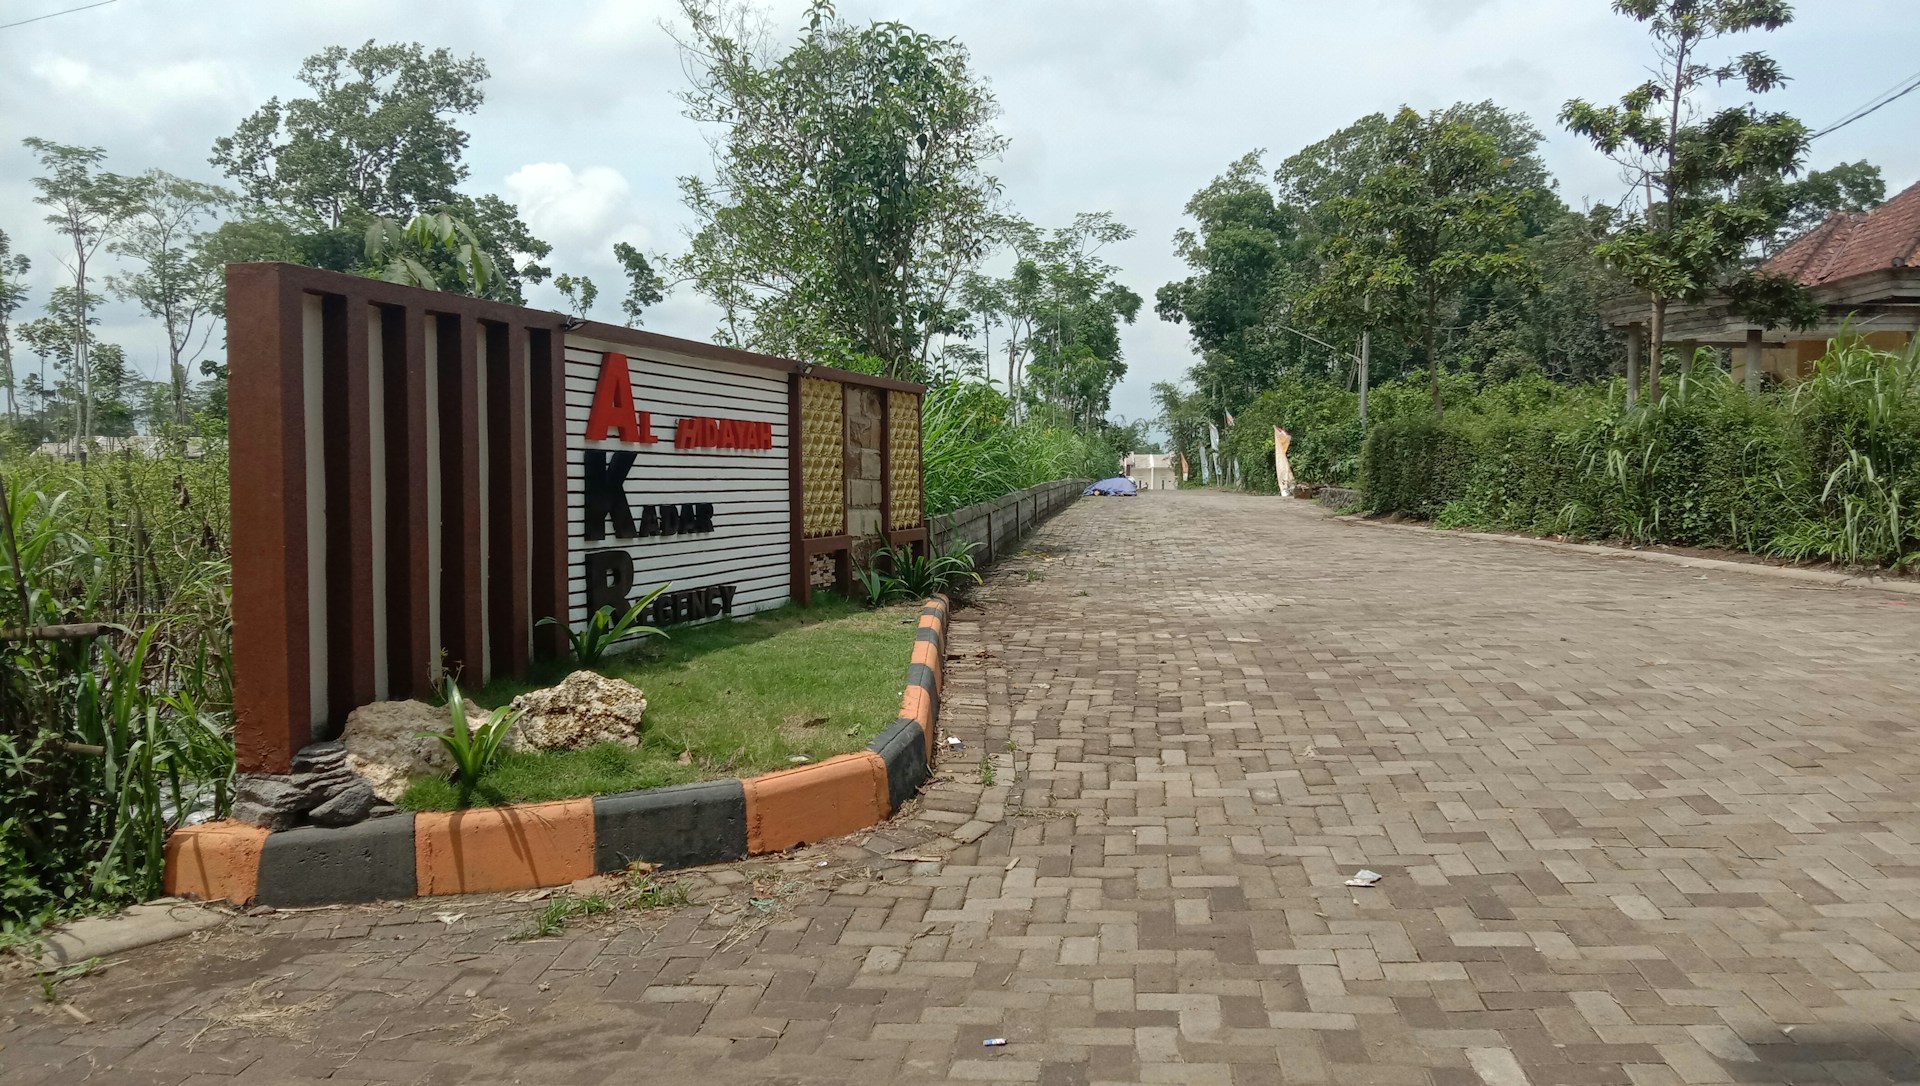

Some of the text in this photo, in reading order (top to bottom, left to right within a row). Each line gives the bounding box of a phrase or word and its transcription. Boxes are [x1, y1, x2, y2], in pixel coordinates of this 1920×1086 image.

[585, 352, 773, 450] AL HIDAYAH
[584, 450, 715, 541] KADAR
